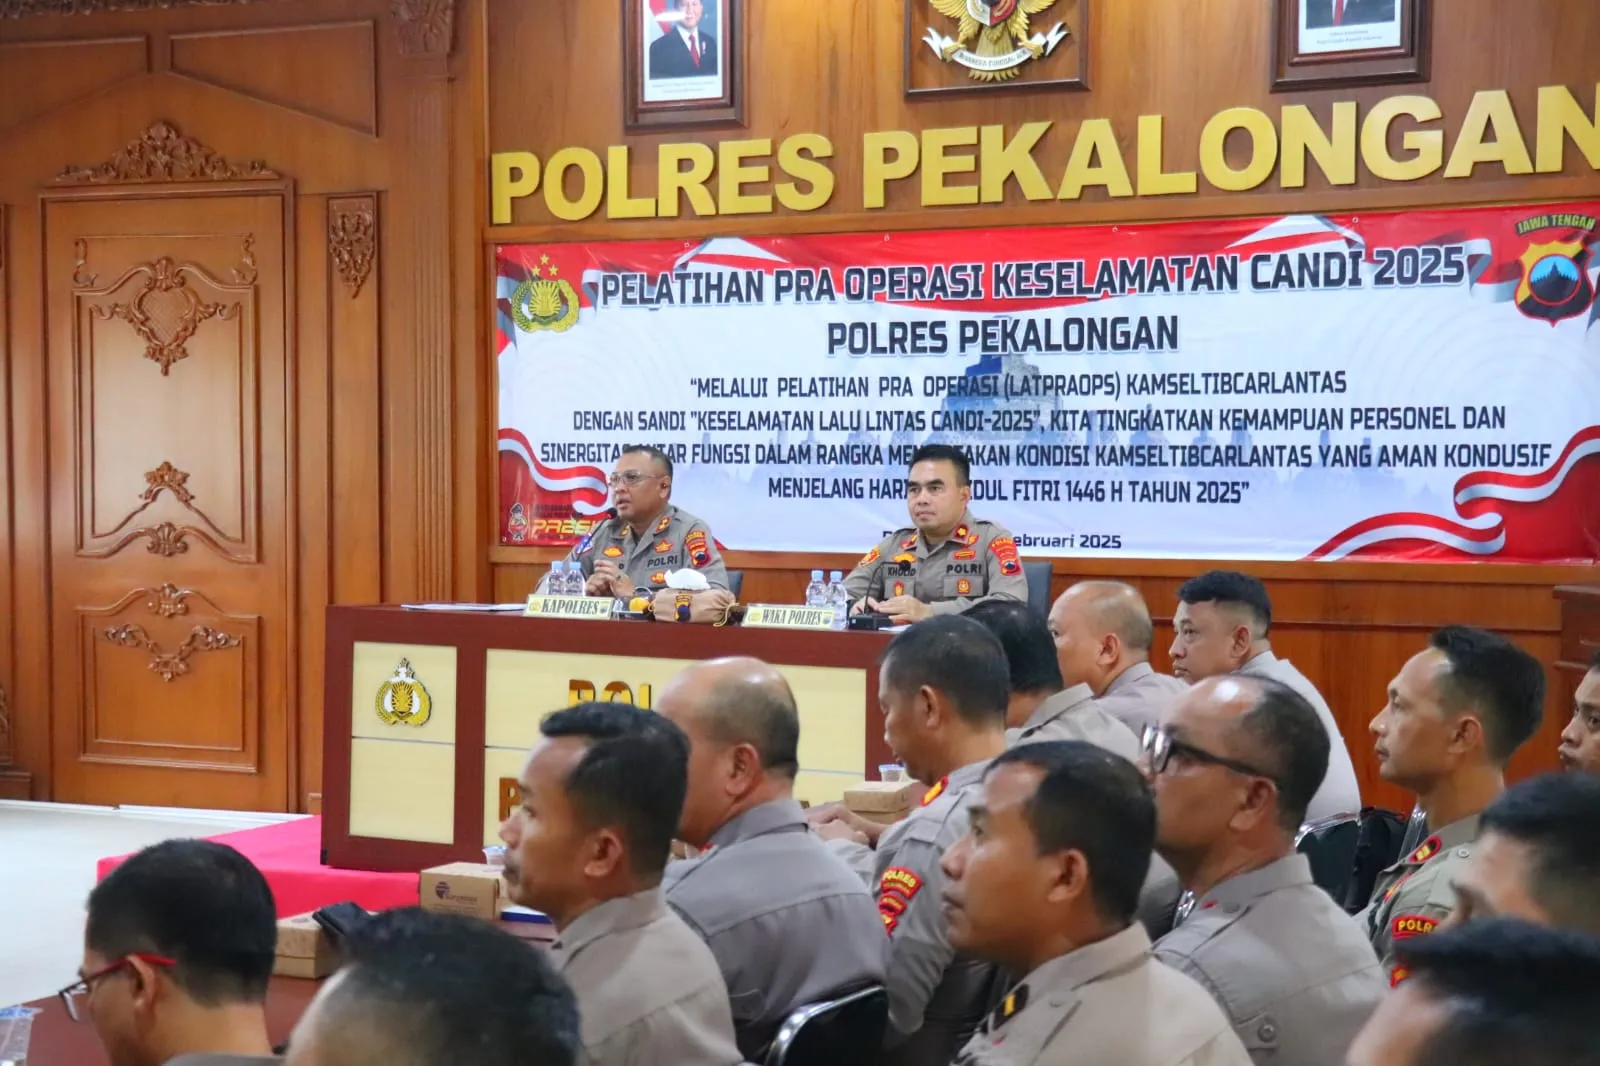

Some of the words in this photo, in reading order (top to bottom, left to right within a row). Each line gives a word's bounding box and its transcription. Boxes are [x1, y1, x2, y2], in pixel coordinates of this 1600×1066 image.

[491, 133, 834, 225] POLRES
[863, 85, 1600, 209] PEKALONGAN
[1517, 215, 1549, 234] JAWA
[1552, 213, 1596, 230] TENGAH
[601, 270, 764, 306] PELATIHAN
[774, 267, 835, 303] PRA
[844, 264, 983, 302] OPERASI
[998, 255, 1239, 298] KESELAMATAN
[1250, 250, 1362, 291] CANDI
[1374, 246, 1466, 285] 2025
[828, 320, 948, 355] POLRES
[959, 315, 1178, 353] PEKALONGAN
[777, 376, 869, 398] PELATIHAN
[879, 376, 913, 397] PRA
[923, 375, 999, 397] OPERASI
[1004, 371, 1121, 401] (LATPRAOPS)
[1126, 370, 1347, 396] KAMSELTIBCARLANTAS
[573, 411, 633, 431] DENGAN
[638, 411, 686, 431] SANDI
[819, 410, 861, 431] LALU
[866, 410, 926, 431] LINTAS
[1050, 410, 1091, 431] KITA
[1096, 409, 1213, 431] TINGKATKAN
[1219, 408, 1344, 431] KEMAMPUAN
[1350, 407, 1456, 430] PERSONEL
[1463, 406, 1505, 429] DAN
[692, 444, 750, 464] FUNGSI
[755, 444, 811, 464] DALAM
[817, 444, 883, 465] RANGKA
[888, 444, 1010, 466] MEAKAN
[1016, 445, 1089, 466] KONDISI
[1095, 445, 1312, 467] KAMSELTIBCARLANTAS
[1320, 445, 1372, 467] YANG
[1377, 445, 1438, 467] AMAN
[1444, 444, 1551, 467] KONDUSIF
[769, 478, 863, 499] MENJELANG
[1013, 480, 1059, 500] FITRI
[1065, 480, 1105, 502] 1446
[1111, 480, 1122, 502] H
[1129, 481, 1190, 503] TAHUN
[1013, 534, 1074, 549] ebruari
[1080, 535, 1121, 549] 2025
[647, 555, 678, 568] POLRI
[946, 563, 982, 575] POLRI
[541, 598, 600, 615] KAPOLRES
[762, 608, 787, 624] WAKA
[788, 609, 823, 626] POLRES
[882, 870, 917, 888] POLRES
[1398, 919, 1434, 933] POLR
